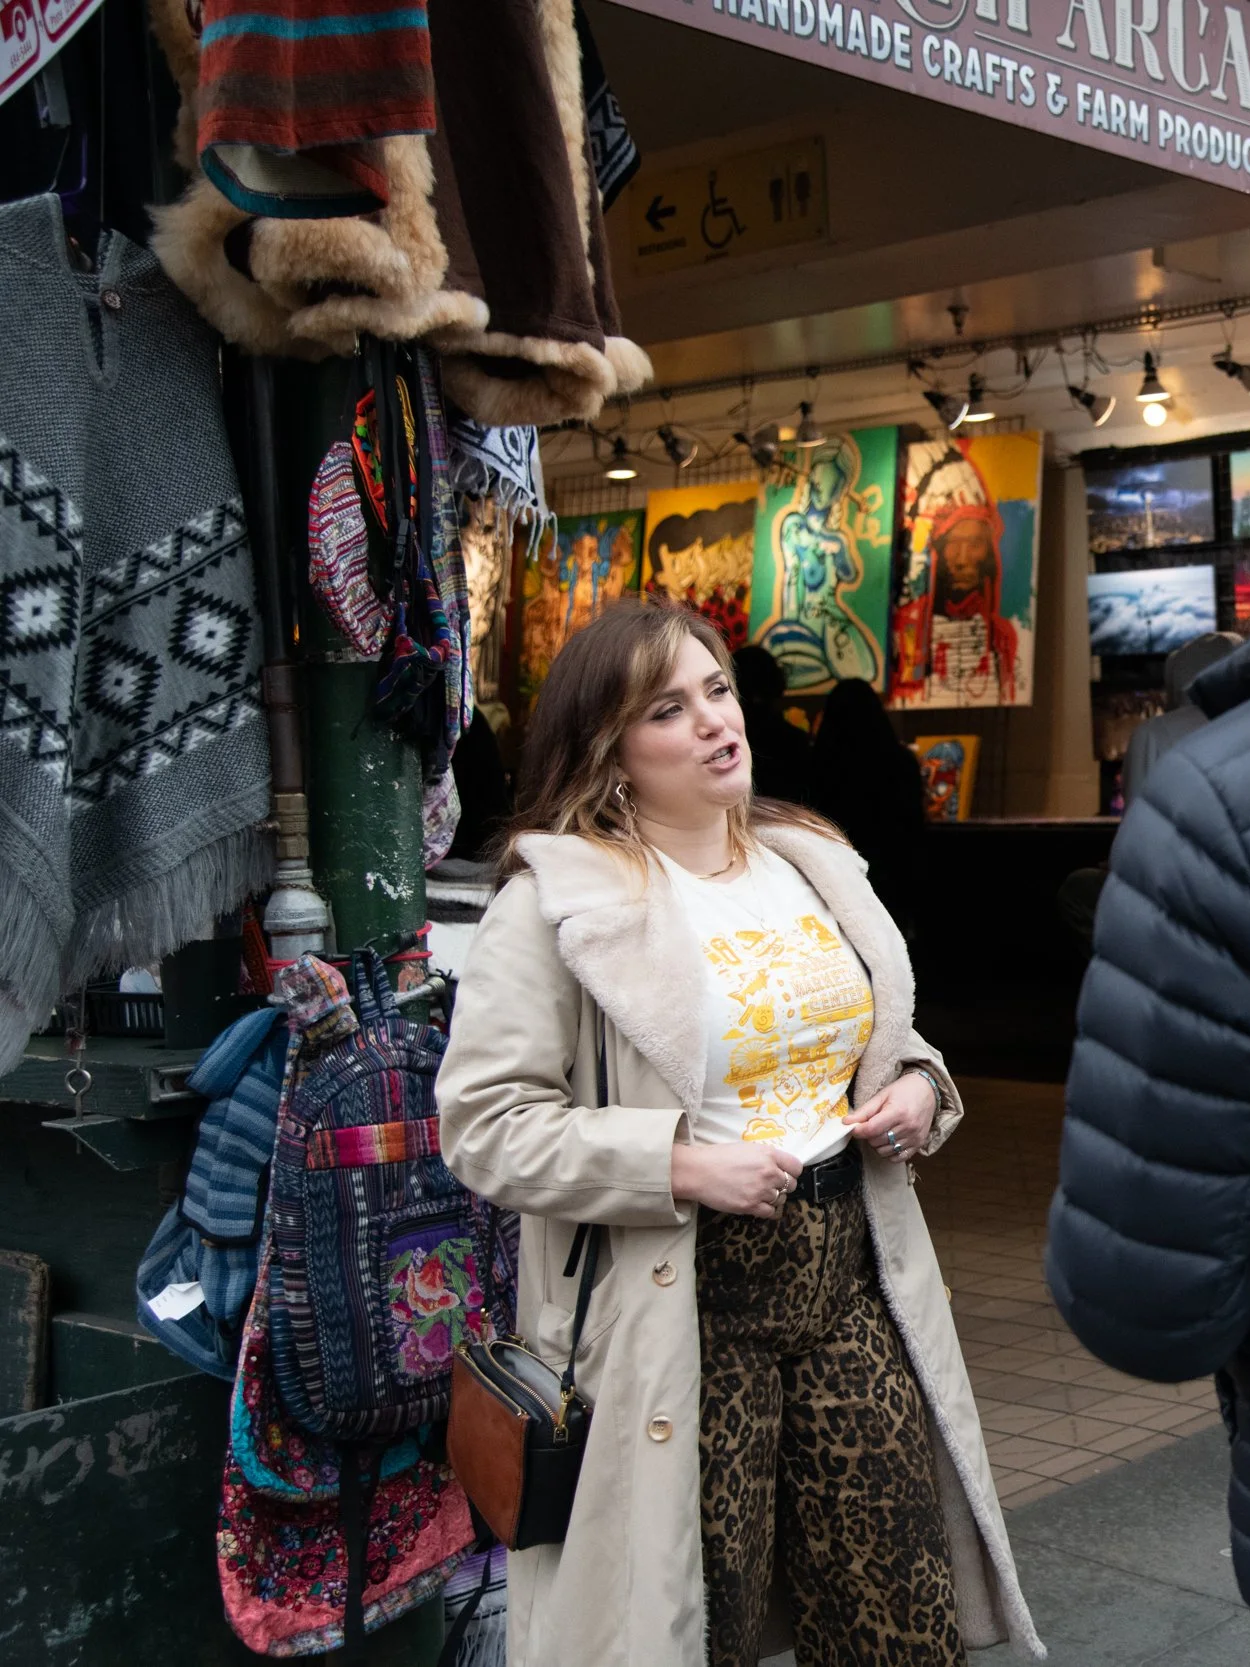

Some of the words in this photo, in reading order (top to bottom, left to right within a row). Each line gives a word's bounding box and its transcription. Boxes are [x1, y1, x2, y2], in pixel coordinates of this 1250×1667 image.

[922, 34, 1037, 107] CRAFTS
[1046, 72, 1068, 116] &
[1077, 82, 1149, 143] FARM
[809, 988, 866, 1013] CENTER
